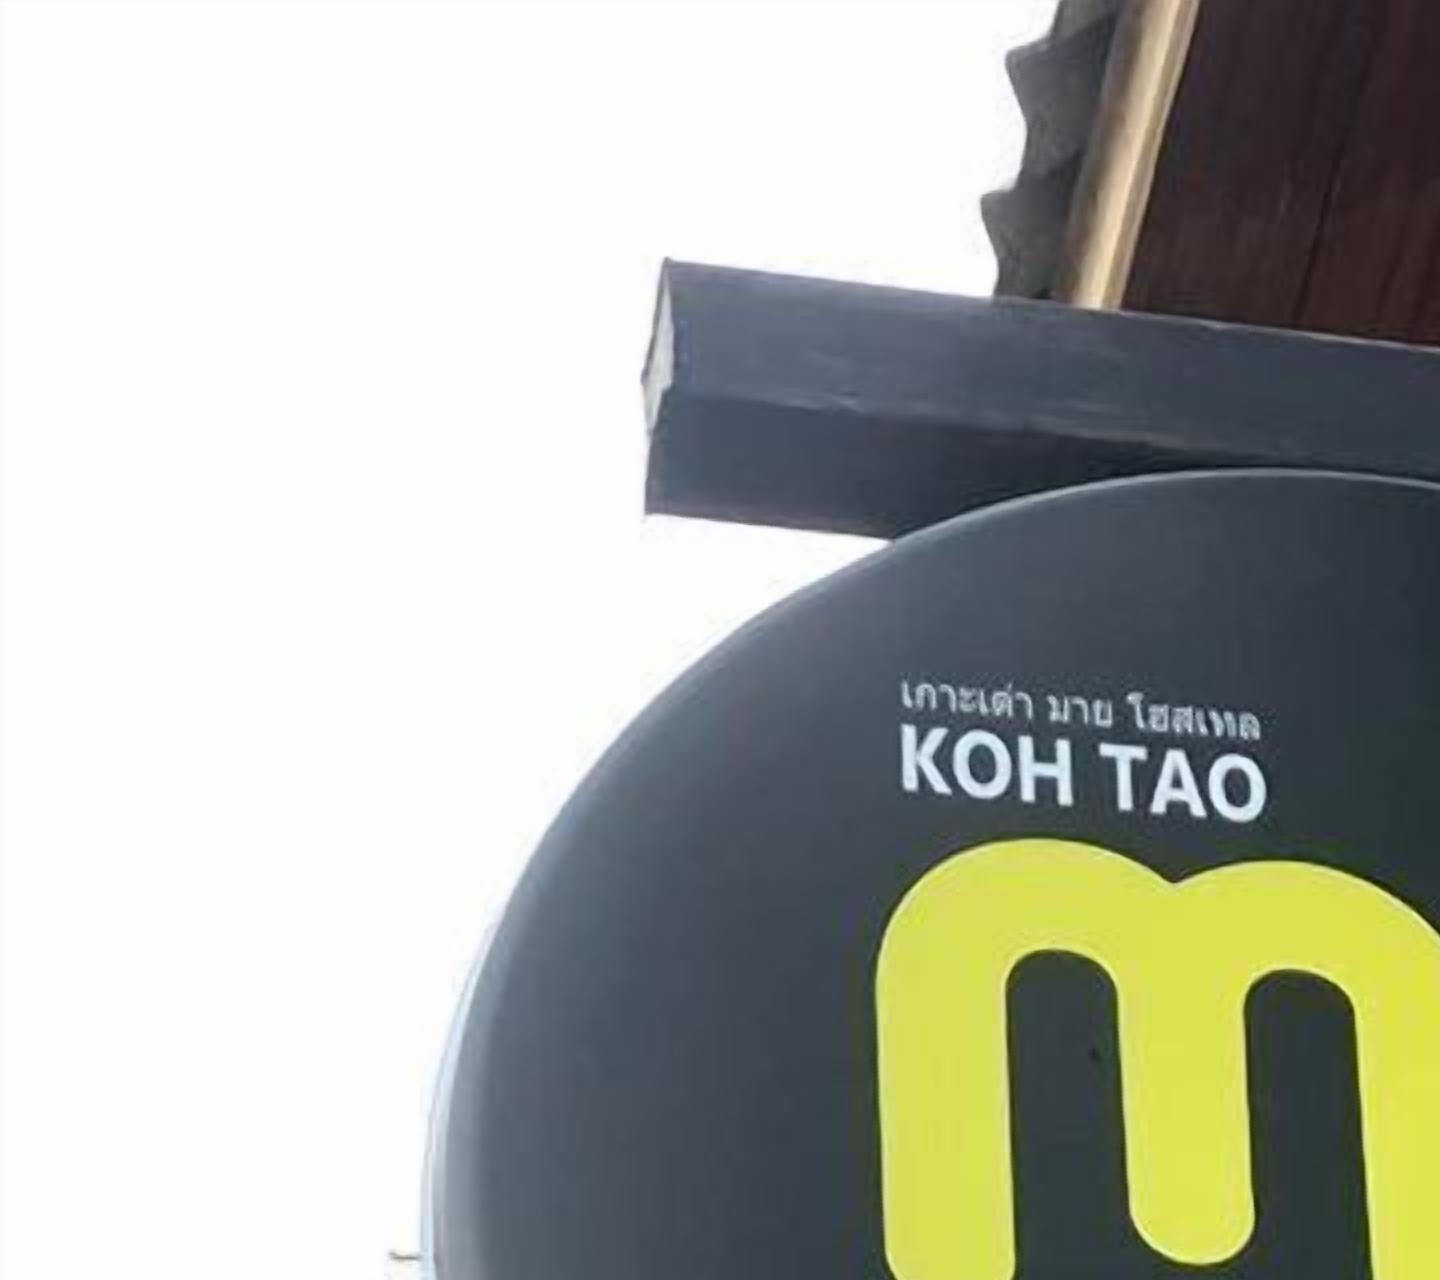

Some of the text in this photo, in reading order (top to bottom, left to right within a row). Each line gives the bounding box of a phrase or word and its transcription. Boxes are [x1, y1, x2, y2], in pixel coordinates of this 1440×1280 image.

[901, 679, 1262, 741] เกาะเต่า มาย โฮสเทล
[901, 723, 1268, 823] KOH TAO
